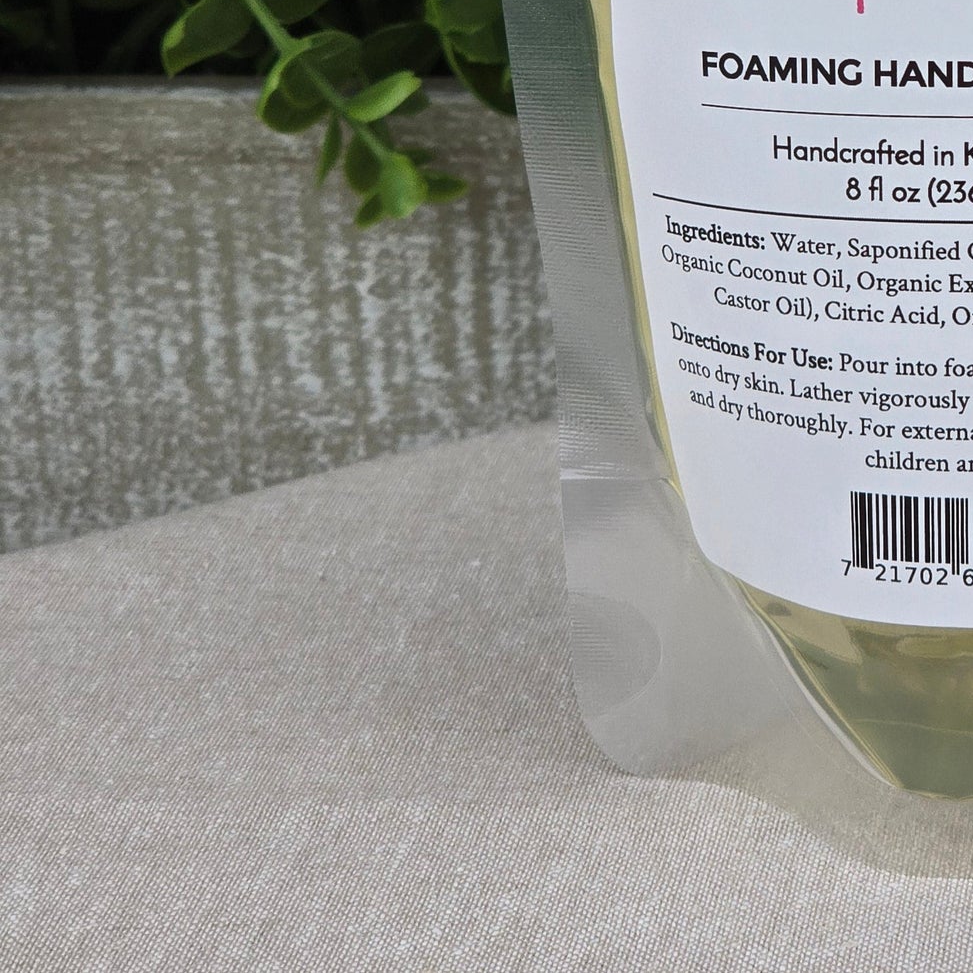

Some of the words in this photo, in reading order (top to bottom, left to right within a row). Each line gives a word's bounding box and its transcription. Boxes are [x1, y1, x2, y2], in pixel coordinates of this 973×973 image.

[701, 50, 863, 87] FOAMING
[773, 134, 925, 166] Handcrafted
[932, 145, 955, 167] in
[845, 176, 862, 201] 8
[867, 175, 884, 202] fl
[891, 186, 921, 204] oz
[664, 214, 766, 251] Ingredients:
[769, 231, 842, 261] Water,
[847, 237, 961, 265] Saponified
[661, 244, 725, 275] Organic
[727, 258, 808, 286] Coconut
[812, 267, 852, 293] Oil,
[856, 270, 943, 298] Organic
[713, 286, 771, 313] Castor
[775, 295, 820, 323] Oil),
[824, 300, 885, 323] Citric
[889, 304, 946, 330] Acid,
[670, 321, 751, 360] Directions
[753, 341, 788, 365] For
[790, 346, 833, 372] Use:
[838, 352, 890, 375] Pour
[894, 356, 938, 377] into
[678, 358, 711, 379] onto
[714, 363, 741, 392] dry
[743, 371, 785, 396] skin.
[789, 378, 854, 404] Lather
[858, 386, 971, 415] vigorously
[689, 389, 716, 409] and
[718, 394, 744, 422] dry
[746, 401, 853, 440] thoroughly.
[858, 416, 896, 439] For
[864, 449, 951, 473] children
[840, 558, 852, 577] 7
[874, 563, 949, 586] 21702
